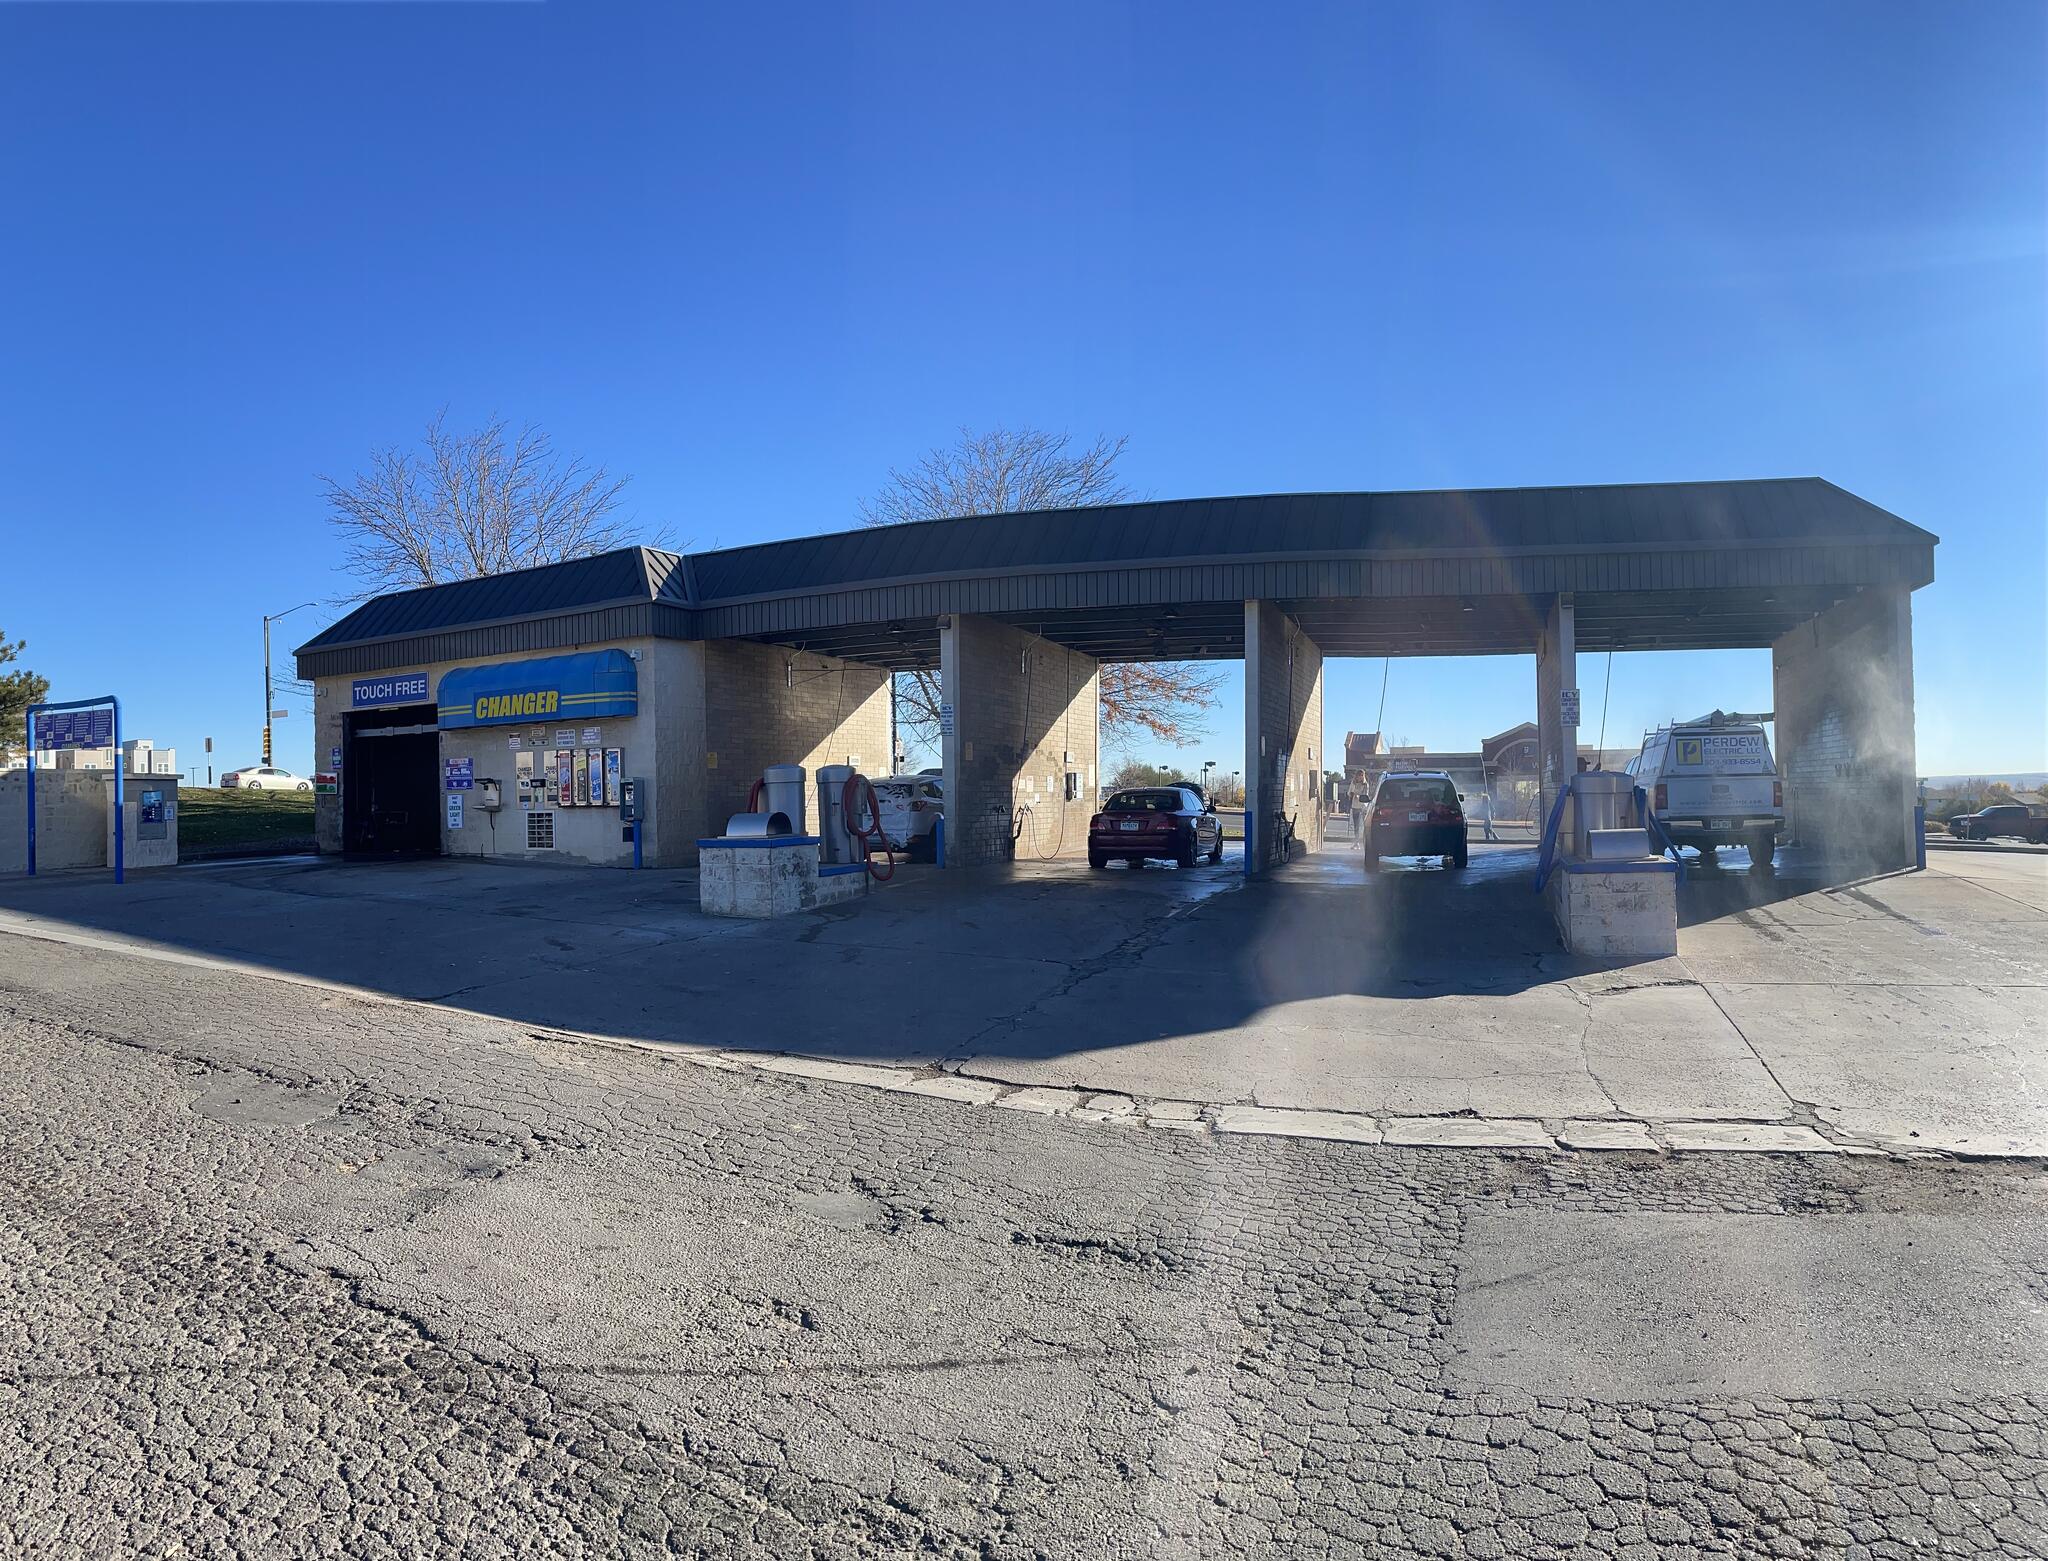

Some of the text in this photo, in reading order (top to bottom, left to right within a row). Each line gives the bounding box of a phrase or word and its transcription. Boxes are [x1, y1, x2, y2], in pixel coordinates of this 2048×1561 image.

[354, 680, 426, 700] TOUCH FREE
[476, 690, 559, 719] CHANGER
[1703, 737, 1760, 747] PERDEW
[1745, 747, 1761, 755] LLC
